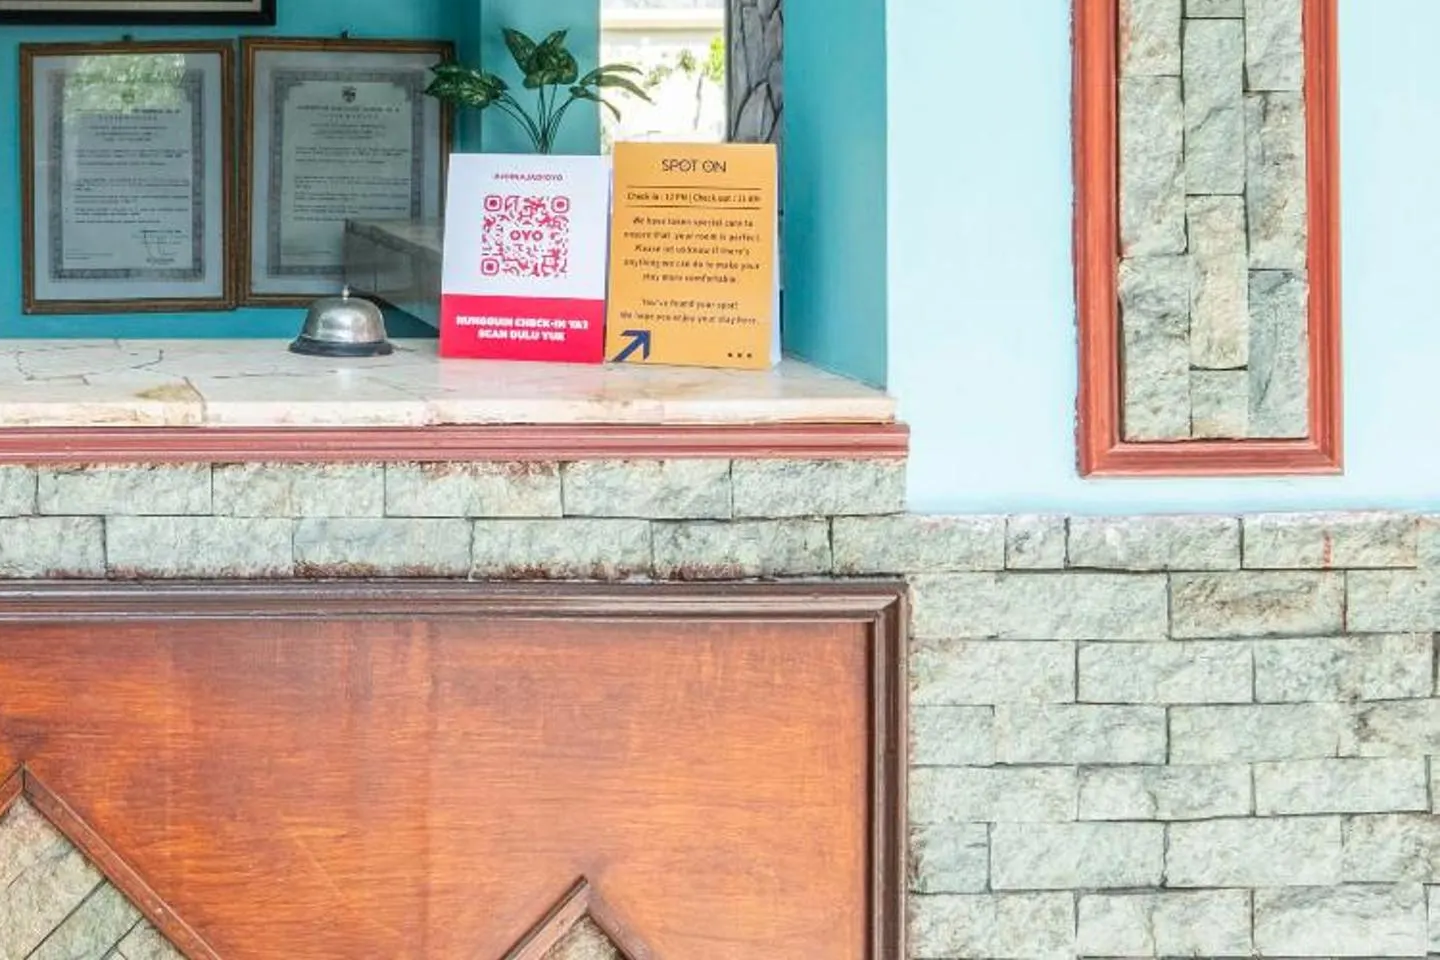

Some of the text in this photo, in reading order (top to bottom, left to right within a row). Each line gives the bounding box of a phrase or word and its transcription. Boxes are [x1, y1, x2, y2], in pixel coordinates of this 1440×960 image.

[661, 159, 727, 173] SPOT ON
[510, 230, 544, 241] OYO
[478, 328, 508, 339] SCAN
[509, 329, 540, 340] DULU
